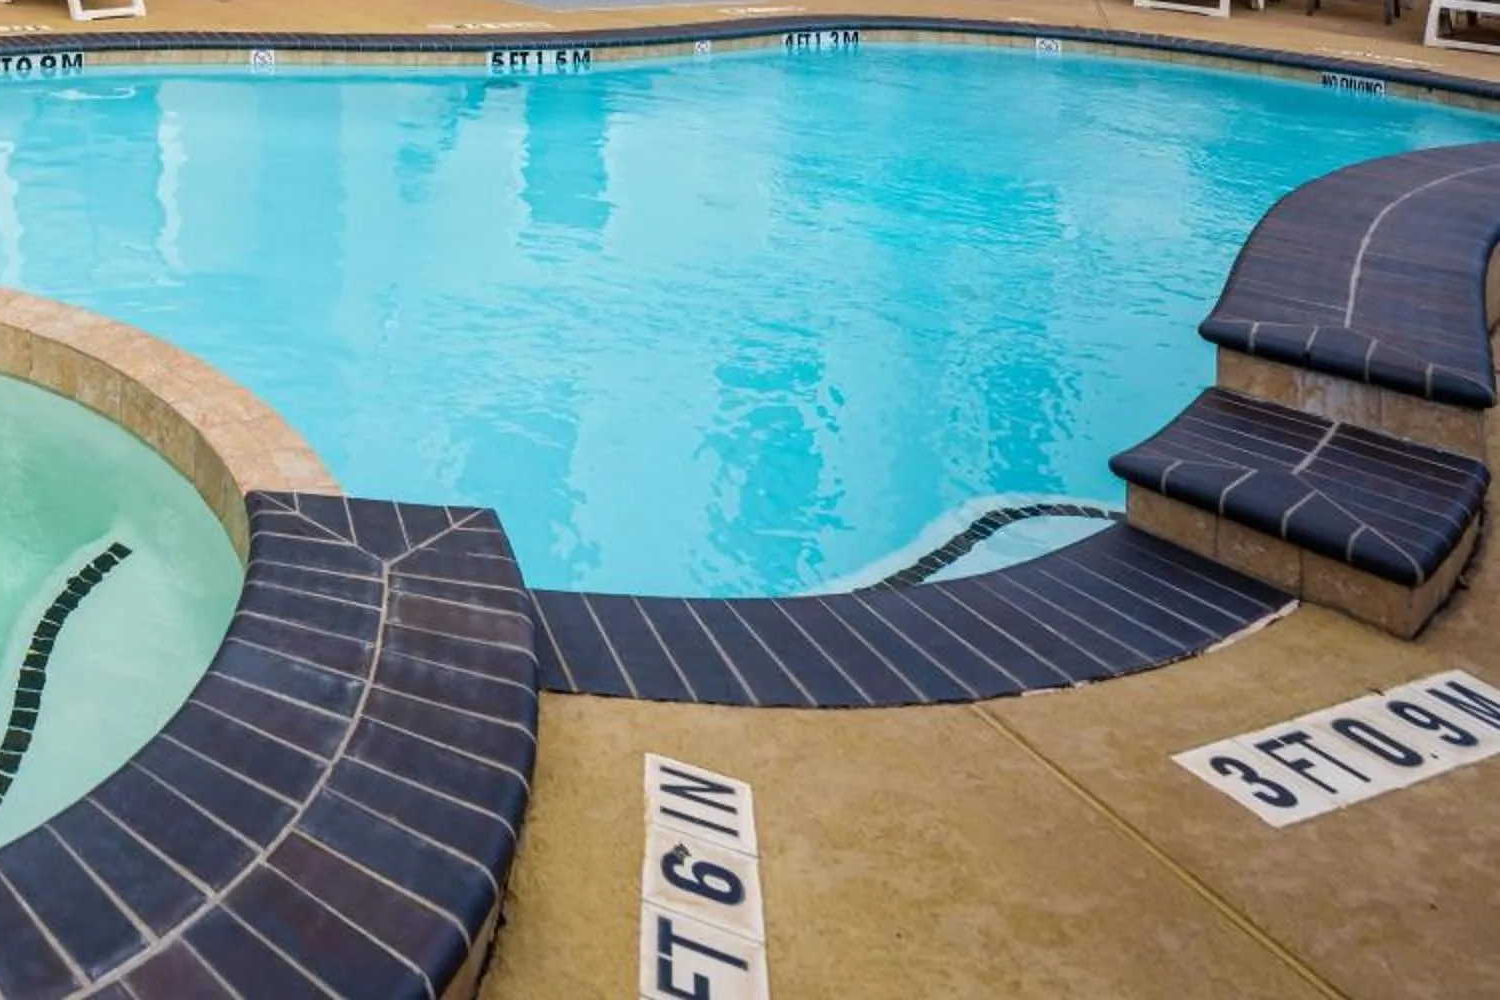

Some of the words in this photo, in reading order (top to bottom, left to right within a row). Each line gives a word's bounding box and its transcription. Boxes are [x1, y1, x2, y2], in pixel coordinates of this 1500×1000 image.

[659, 765, 739, 838] IN
[1209, 755, 1299, 808] 3
[1255, 730, 1371, 795] FT
[660, 842, 746, 906] 6
